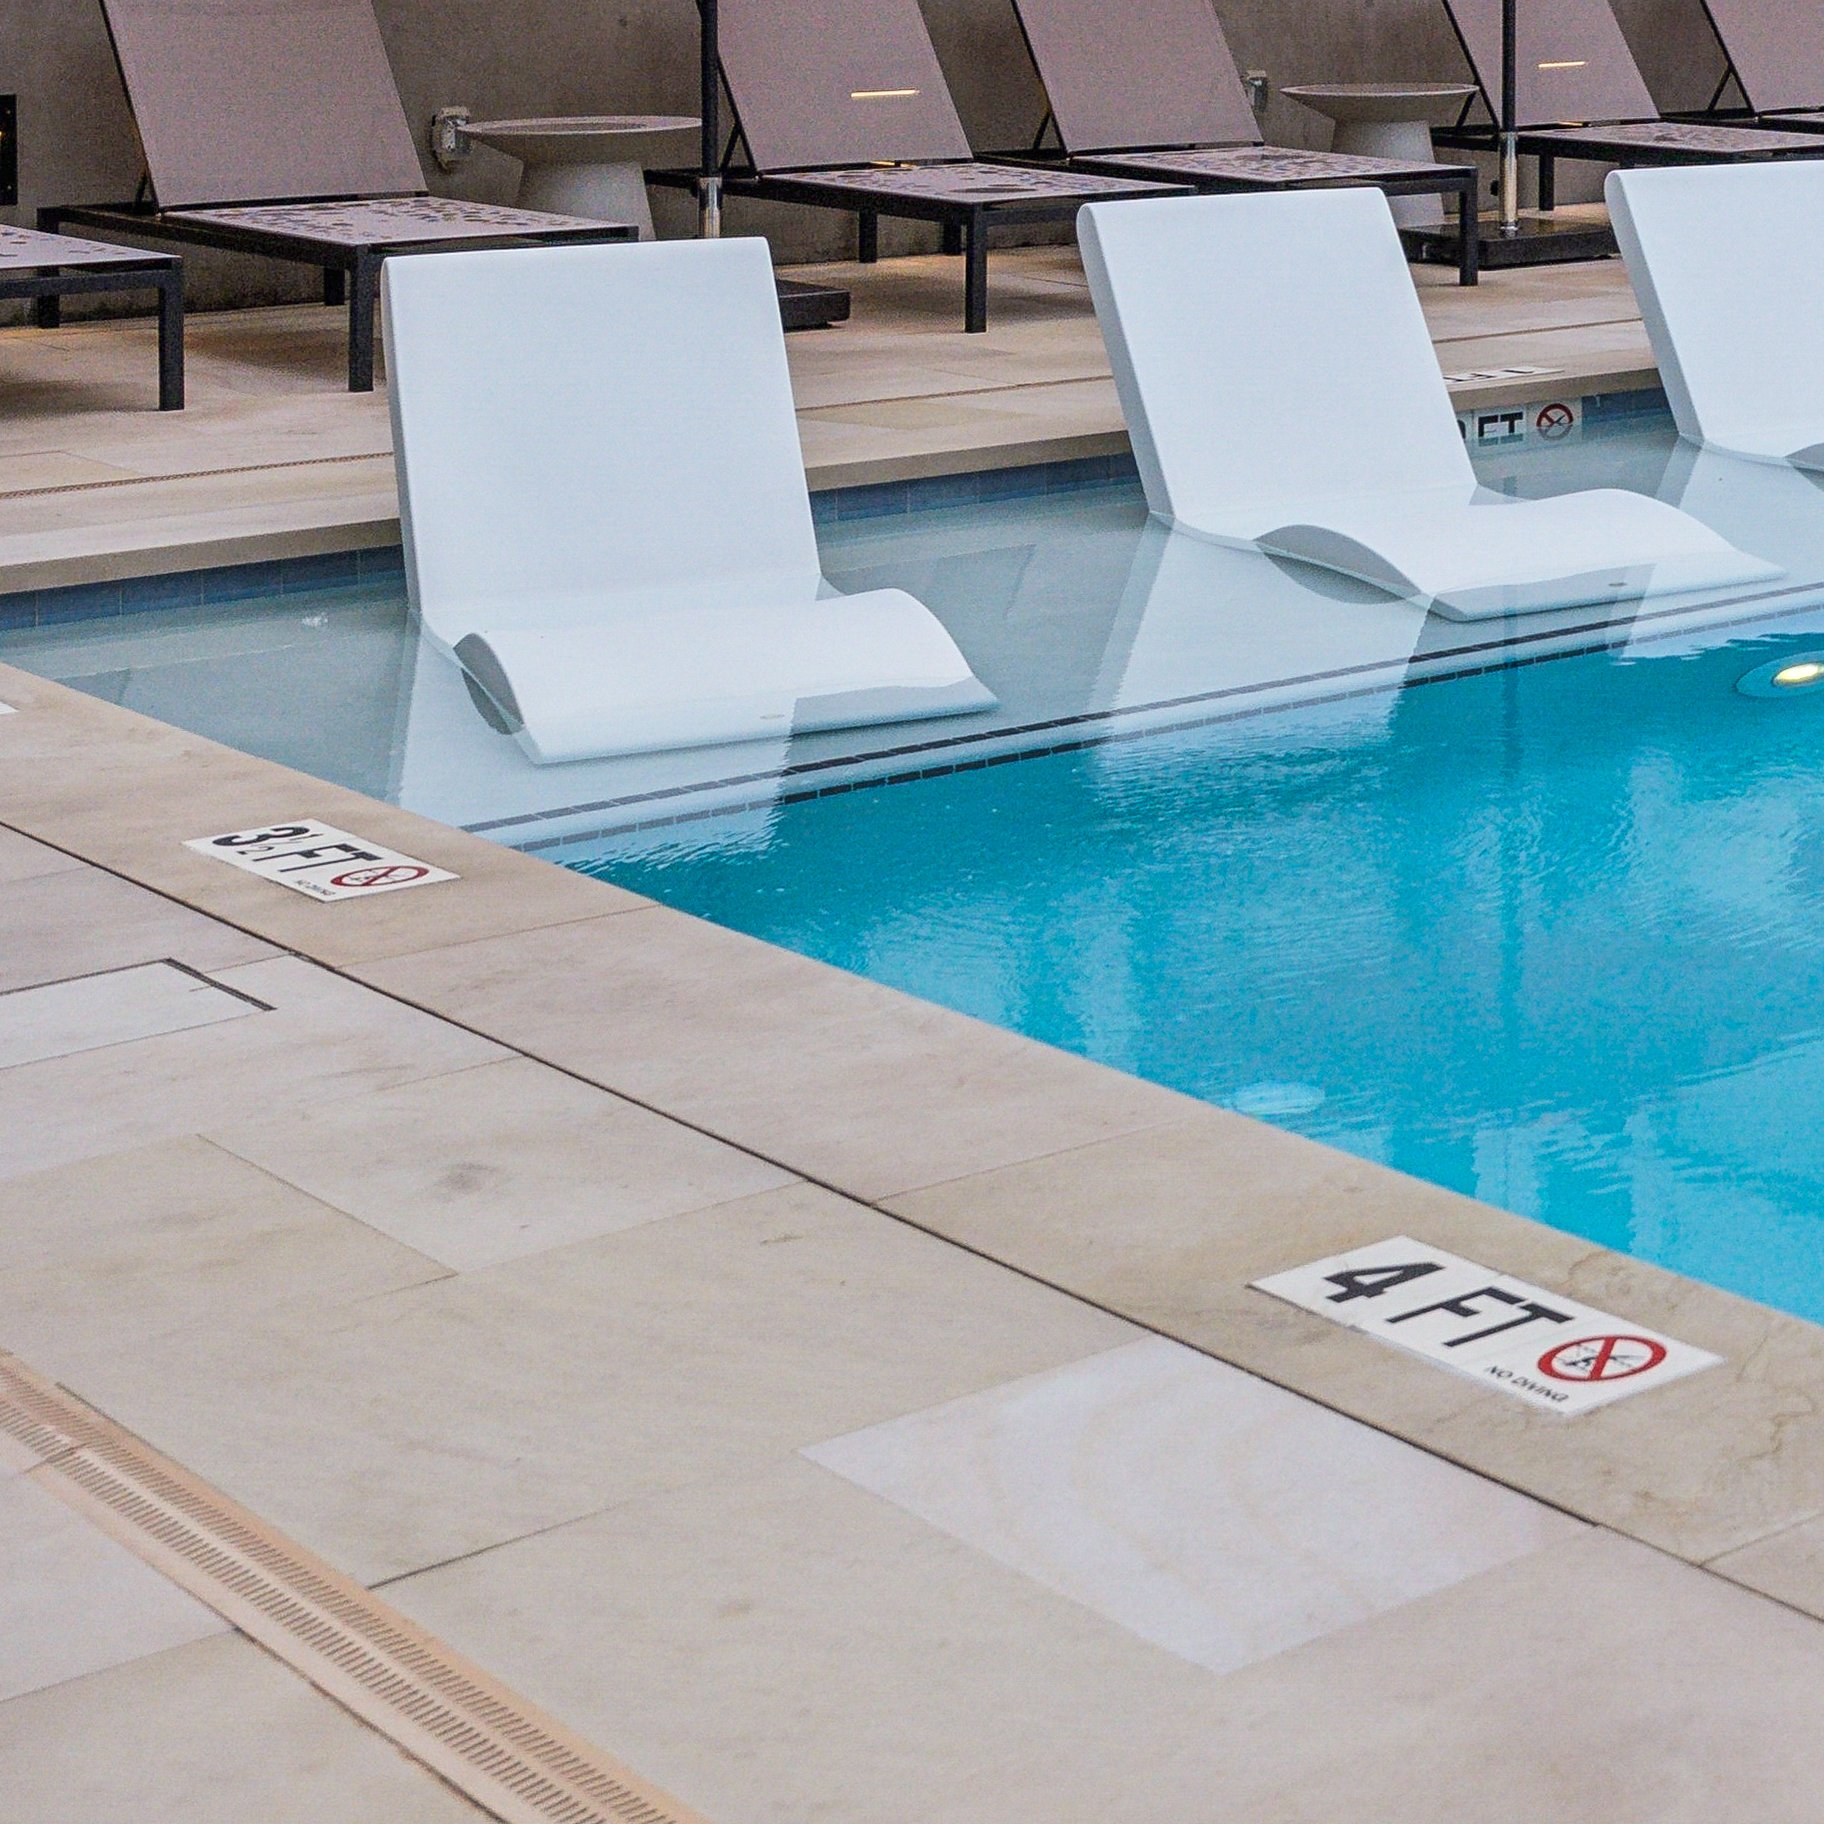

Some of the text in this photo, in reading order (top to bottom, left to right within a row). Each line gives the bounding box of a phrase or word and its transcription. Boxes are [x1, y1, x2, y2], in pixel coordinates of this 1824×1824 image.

[252, 843, 383, 873] FT
[1323, 1261, 1576, 1349] 4 FT
[1484, 1365, 1569, 1403] NO DIVING
